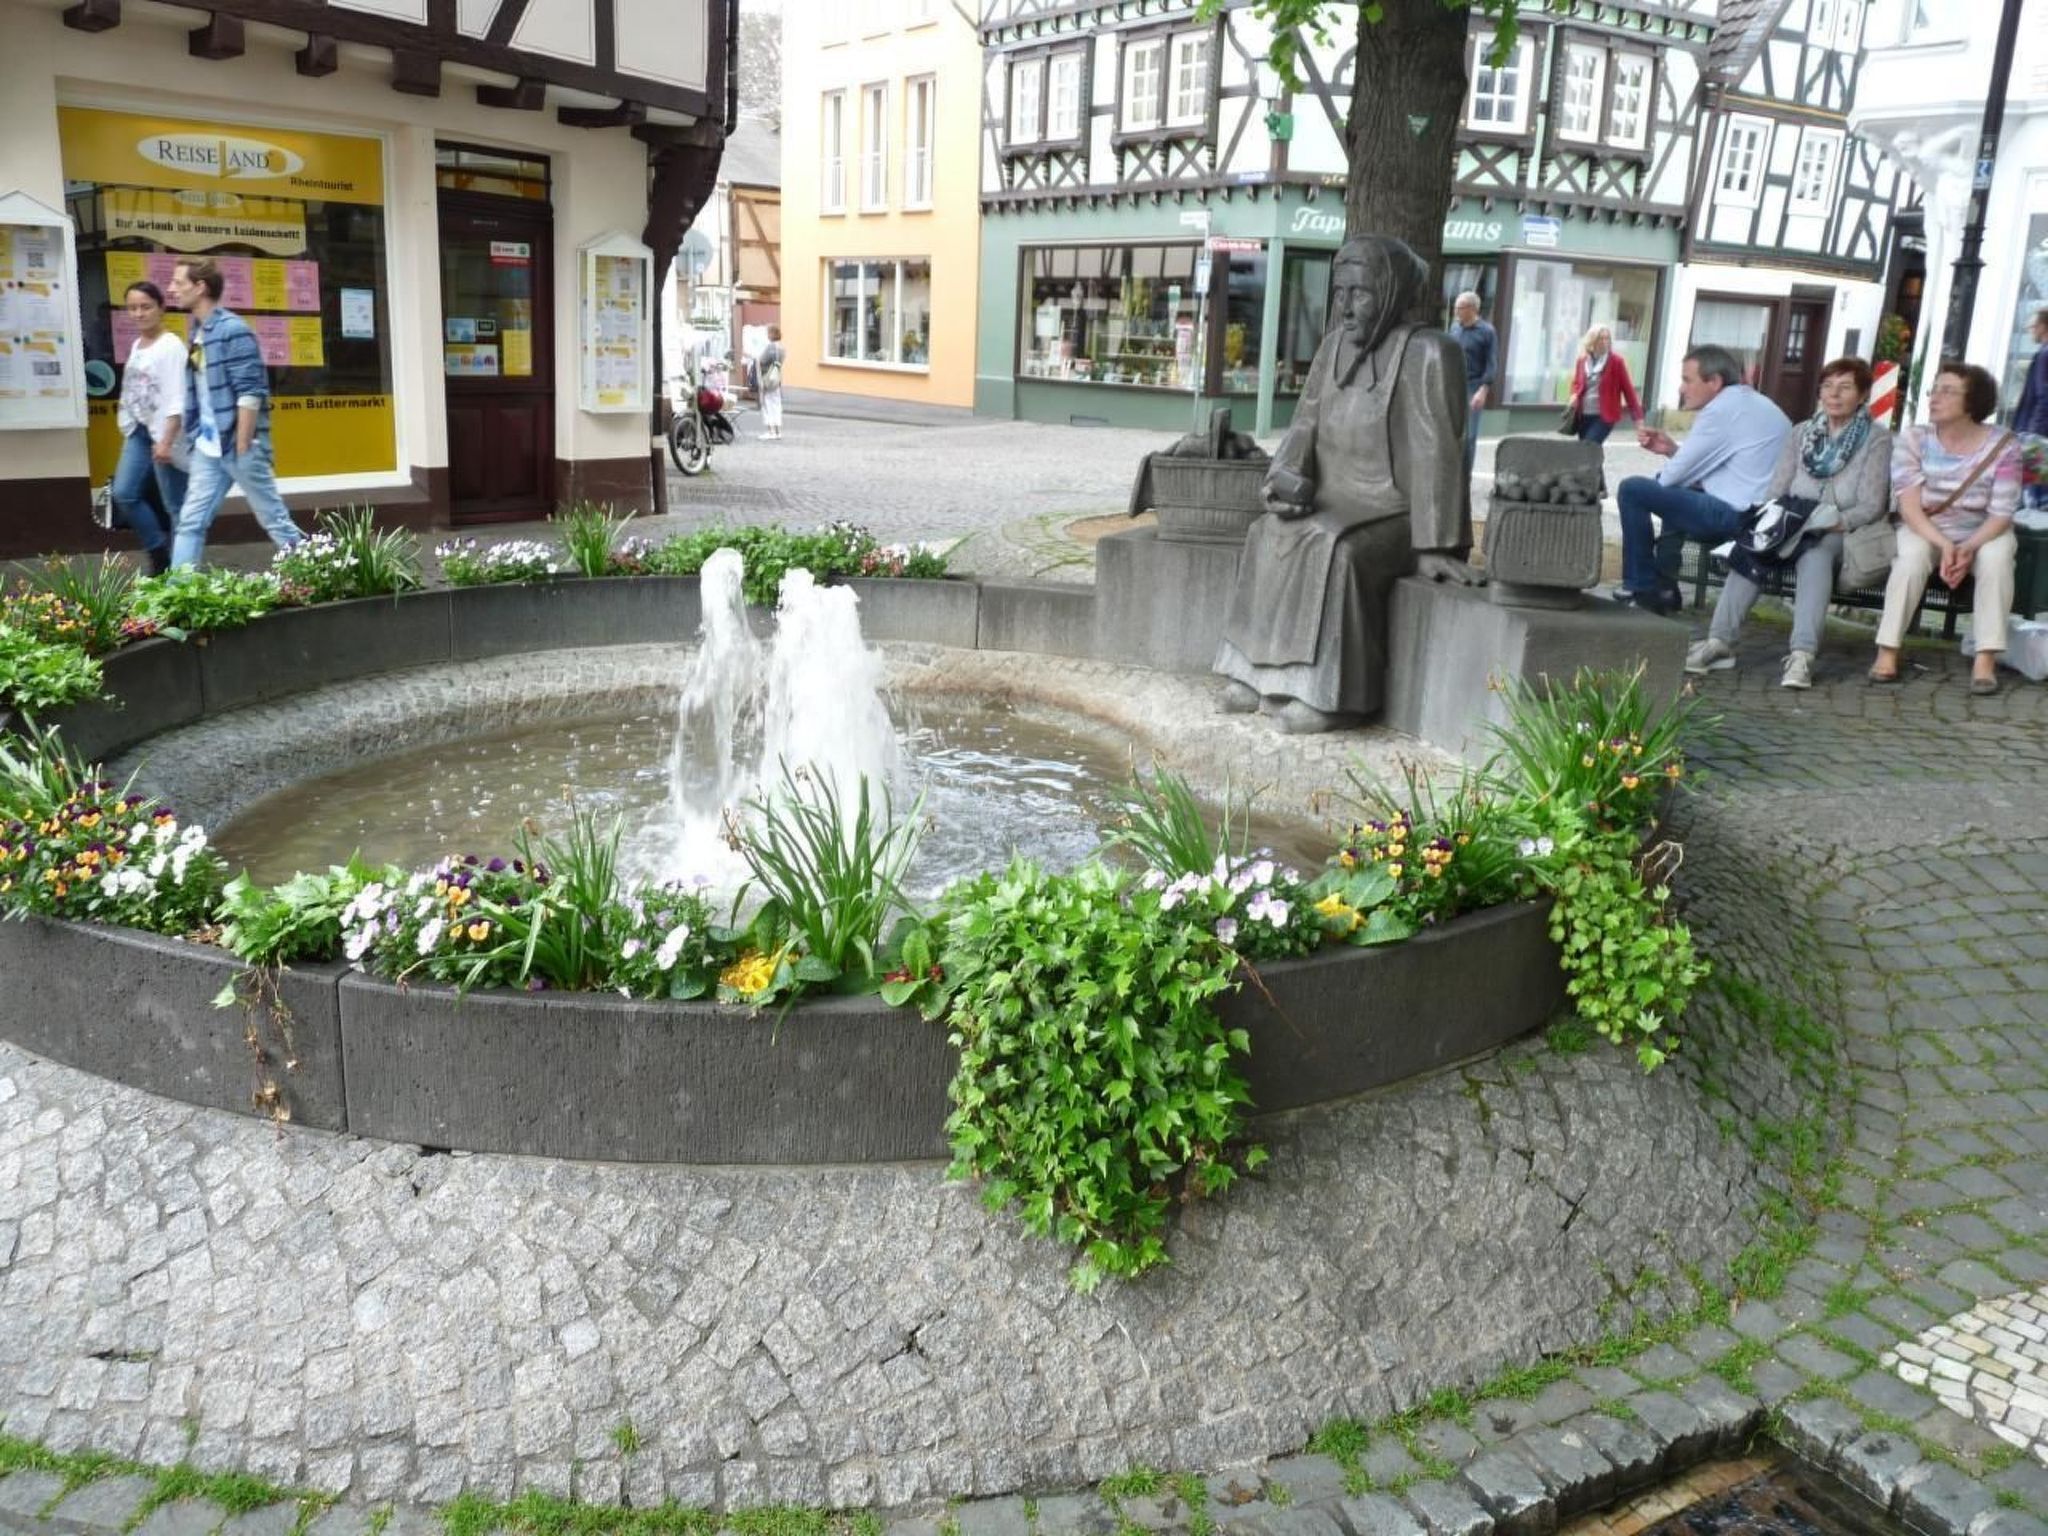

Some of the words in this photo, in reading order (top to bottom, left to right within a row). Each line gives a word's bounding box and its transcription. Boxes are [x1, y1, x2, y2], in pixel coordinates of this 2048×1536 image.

[1291, 206, 1346, 234] Tap
[281, 401, 302, 411] am
[306, 396, 386, 410] Buttermarkt
